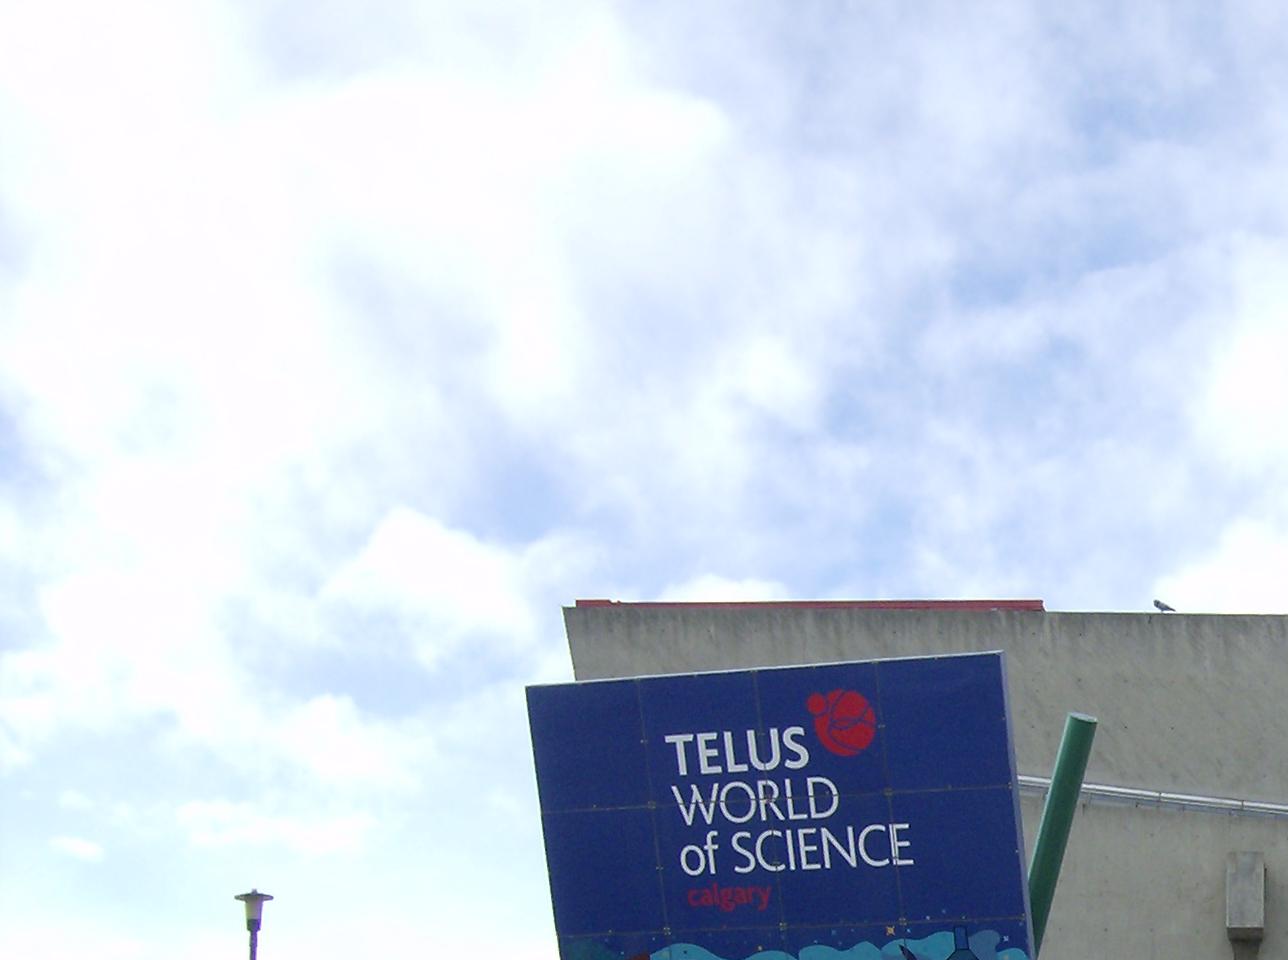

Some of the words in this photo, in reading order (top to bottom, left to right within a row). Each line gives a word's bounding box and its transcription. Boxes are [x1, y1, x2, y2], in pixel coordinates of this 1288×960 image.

[664, 726, 809, 775] TELUS
[671, 776, 839, 826] WORLD
[680, 830, 719, 876] of
[731, 823, 914, 873] SCIENCE
[687, 882, 771, 912] calgary
